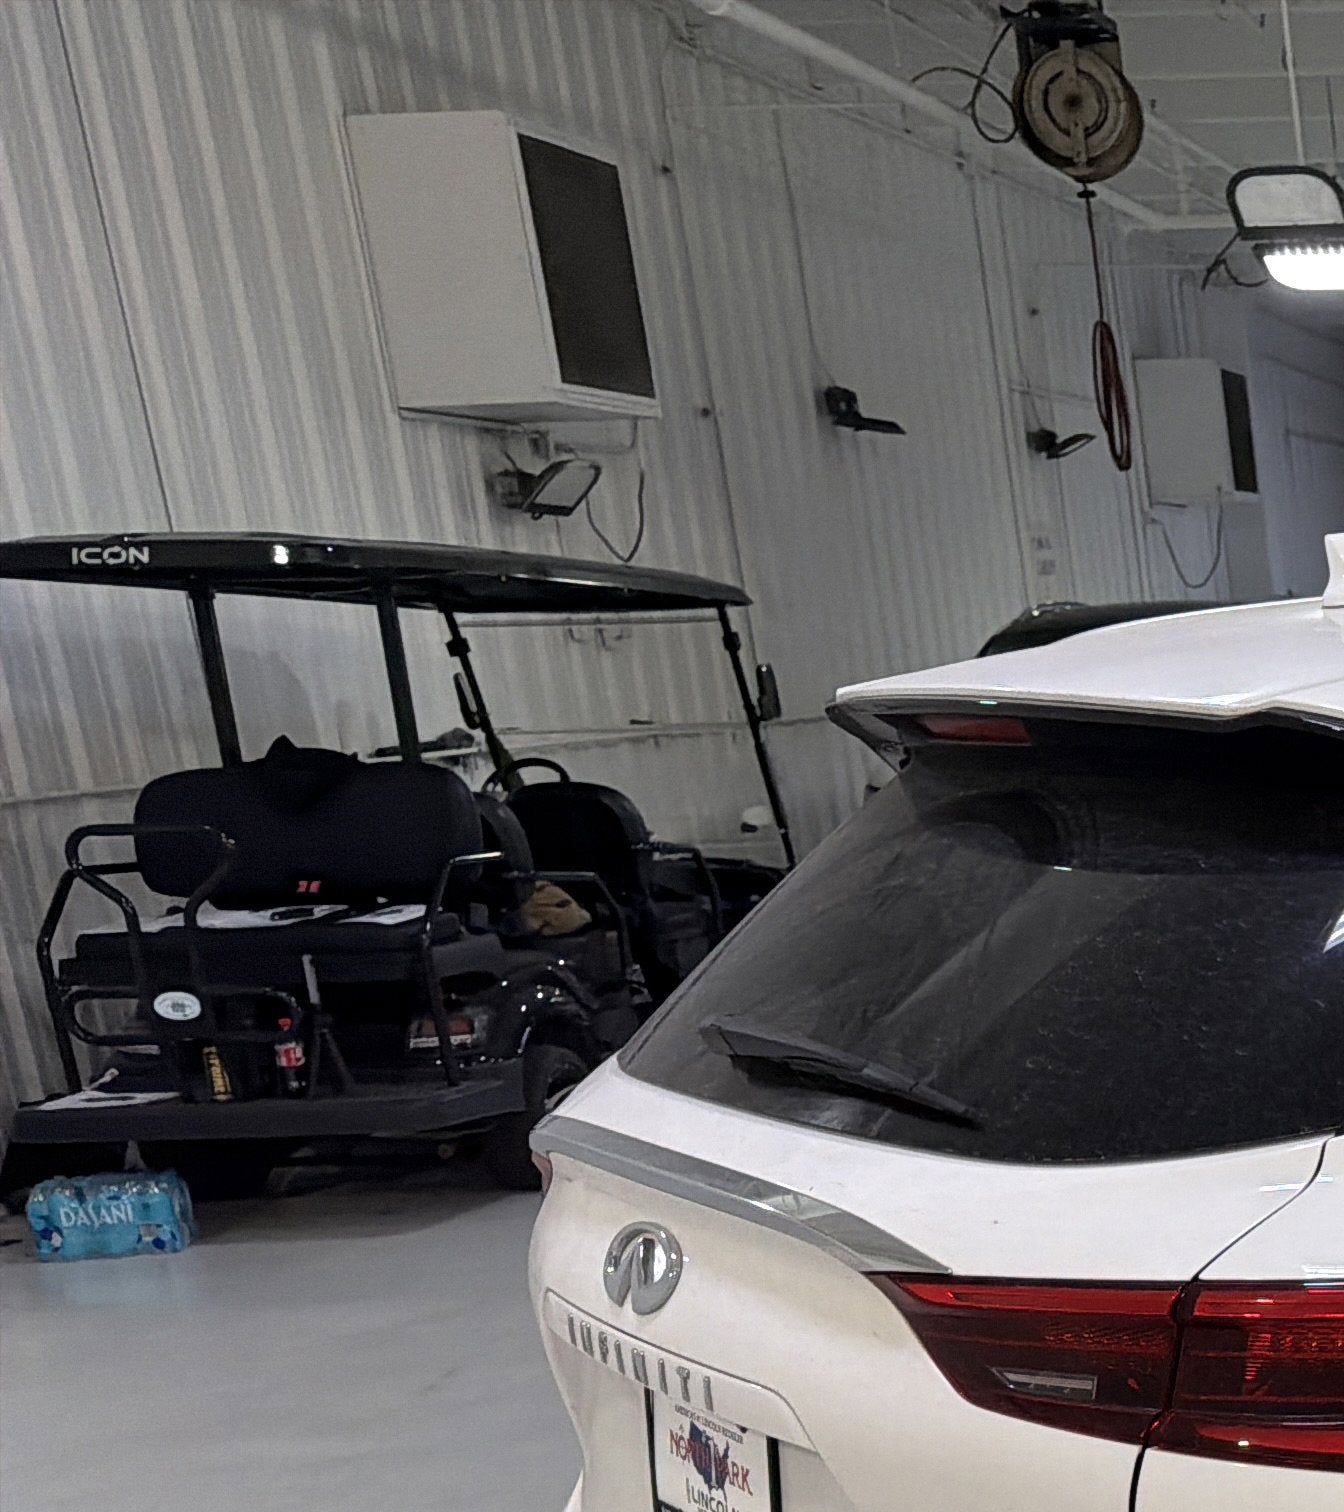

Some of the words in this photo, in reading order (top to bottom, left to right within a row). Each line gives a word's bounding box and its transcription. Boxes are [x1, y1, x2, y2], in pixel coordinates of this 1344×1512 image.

[72, 545, 149, 565] ICON
[60, 1202, 133, 1230] DASANI
[568, 1312, 713, 1411] INFINITI
